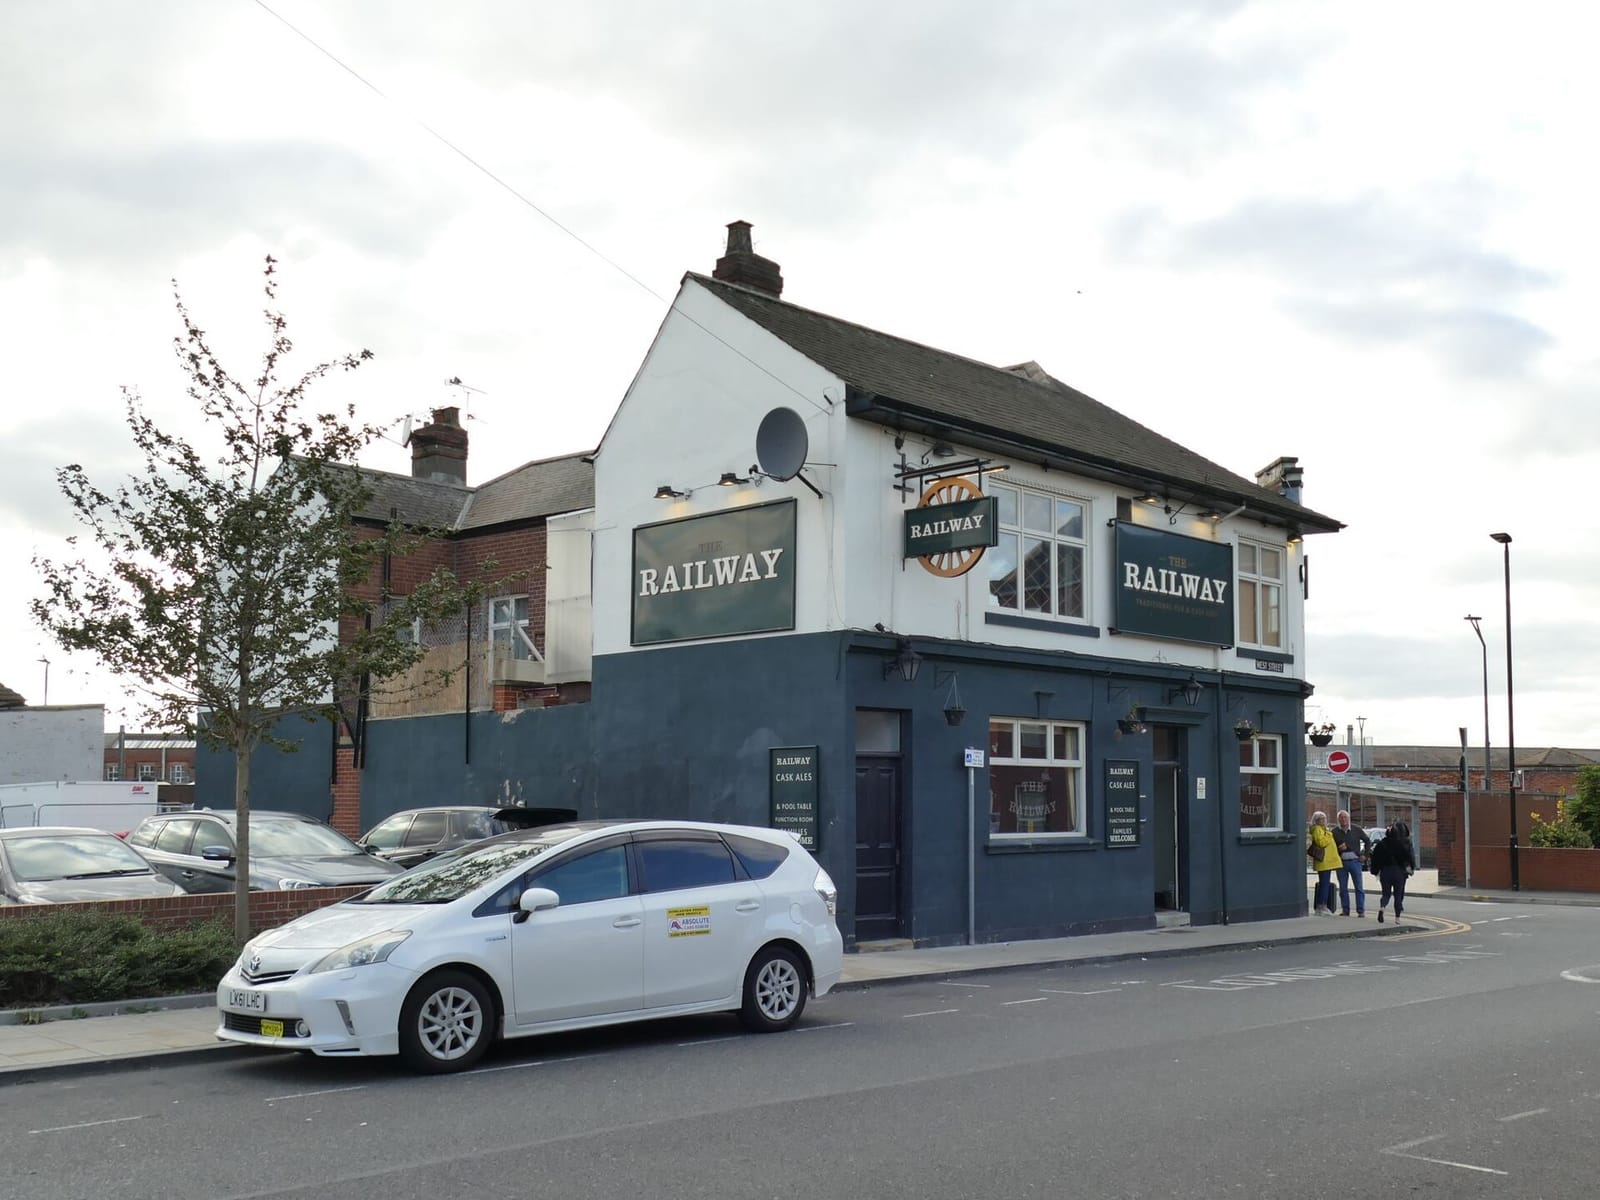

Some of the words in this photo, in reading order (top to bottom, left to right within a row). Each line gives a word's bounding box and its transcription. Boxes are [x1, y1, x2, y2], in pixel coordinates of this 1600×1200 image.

[910, 514, 984, 539] RAILWAY
[1168, 555, 1188, 569] THE
[639, 548, 784, 597] RAILWAY
[1123, 562, 1228, 604] RAILWAY
[776, 757, 811, 766] RAILWAY
[776, 773, 794, 782] CASK
[795, 772, 812, 781] ALES
[1021, 781, 1047, 793] THE
[1109, 781, 1122, 789] CASK
[1123, 781, 1135, 789] ALES
[1248, 785, 1263, 796] THE
[1008, 800, 1057, 817] RAILWAY
[1109, 834, 1136, 842] WELCOME
[246, 993, 260, 1009] LHC
